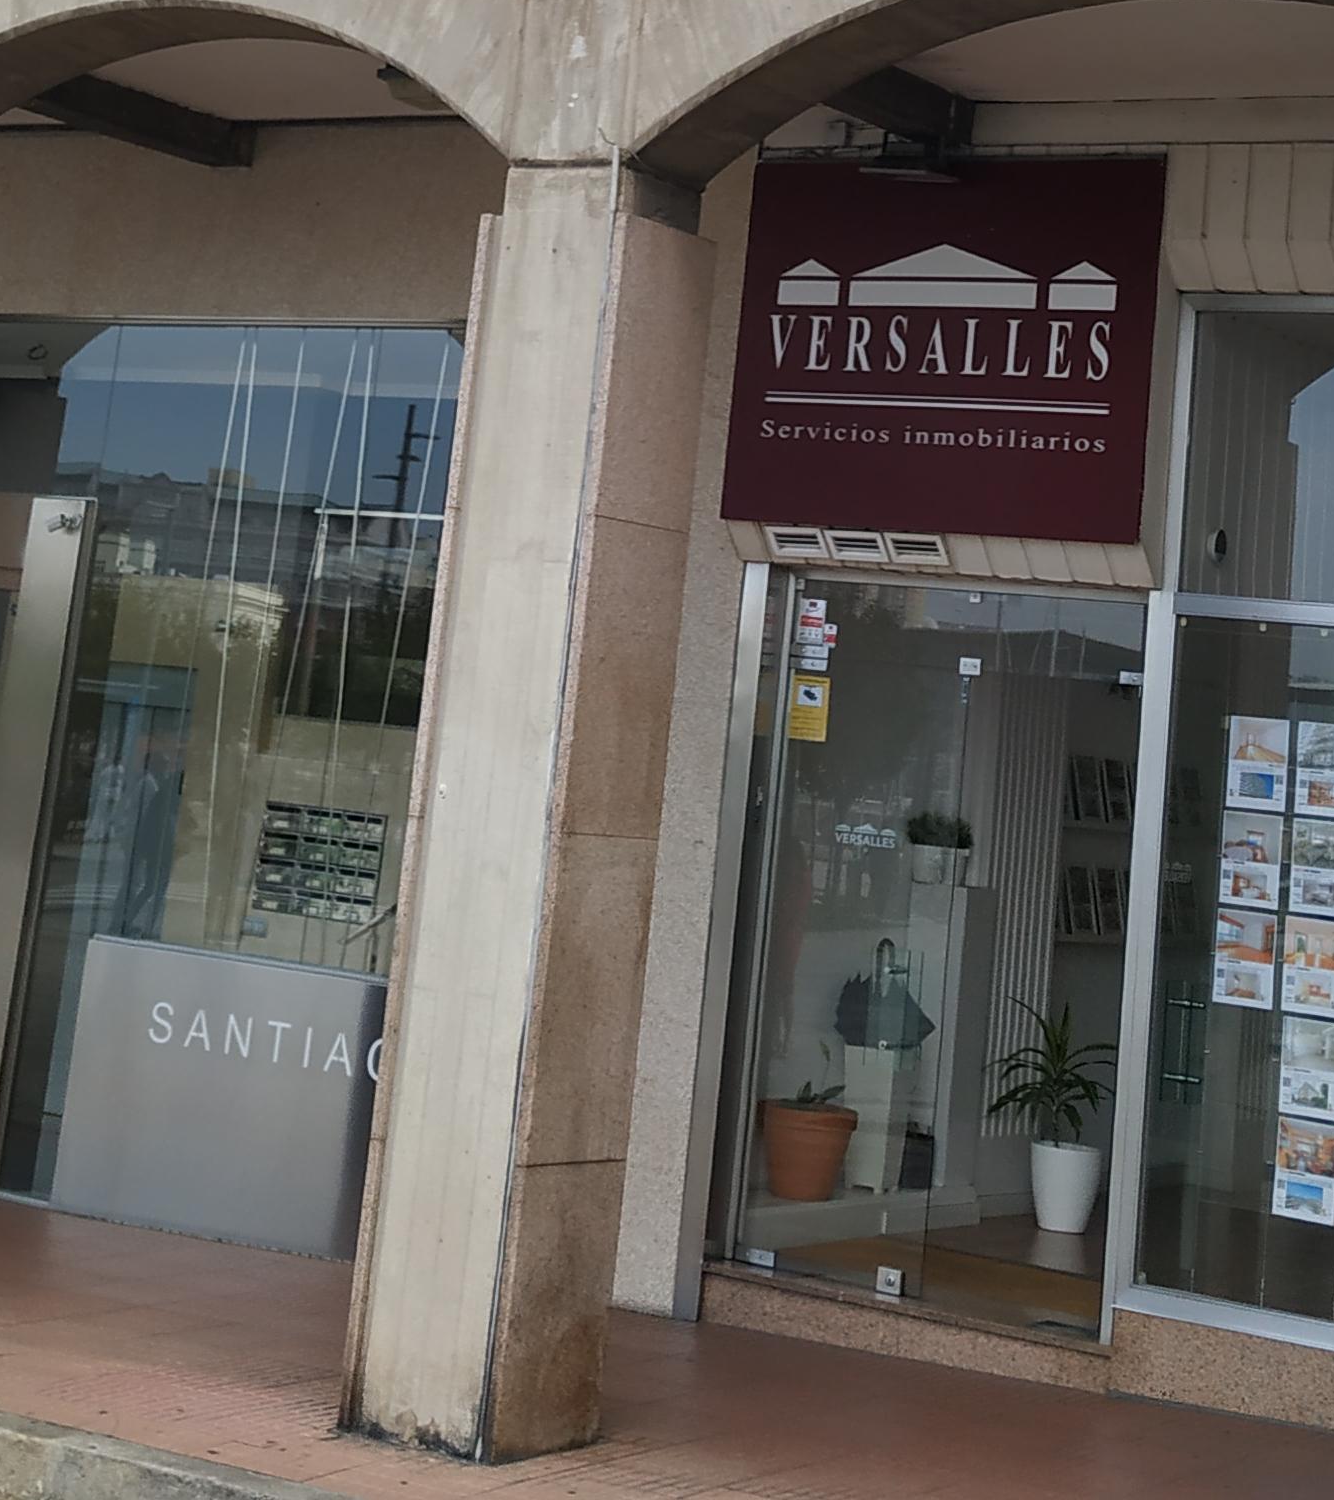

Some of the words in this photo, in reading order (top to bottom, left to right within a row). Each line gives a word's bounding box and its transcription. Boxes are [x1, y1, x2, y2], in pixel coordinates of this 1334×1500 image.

[770, 314, 1112, 381] VERSALLES
[760, 419, 891, 444] Servicios
[903, 426, 1107, 453] inmobiliarios
[834, 832, 895, 849] VERSALLES
